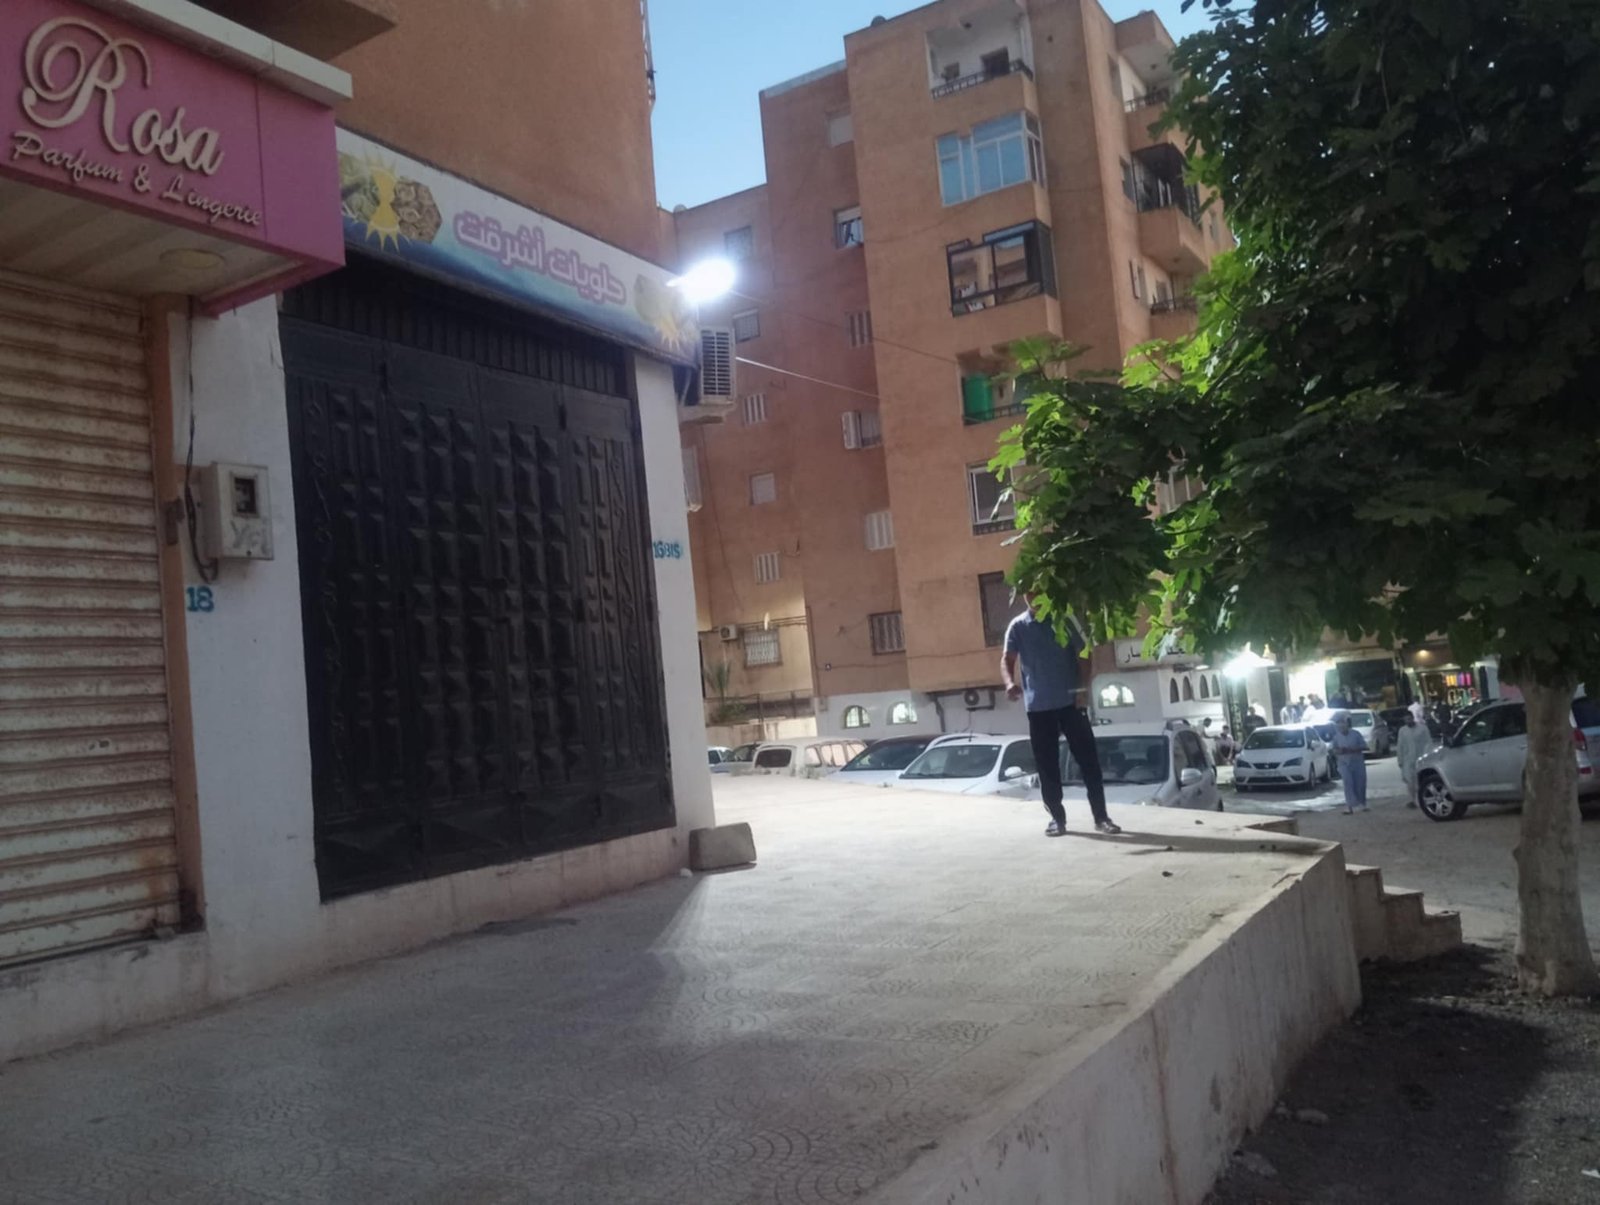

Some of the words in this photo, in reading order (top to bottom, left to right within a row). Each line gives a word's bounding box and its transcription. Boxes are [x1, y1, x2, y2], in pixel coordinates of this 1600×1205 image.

[22, 16, 226, 176] Rosa
[11, 130, 124, 182] Parfum
[133, 163, 152, 193] &
[162, 173, 263, 227] Lingerie
[549, 248, 627, 304] حلويات
[186, 585, 214, 612] 18
